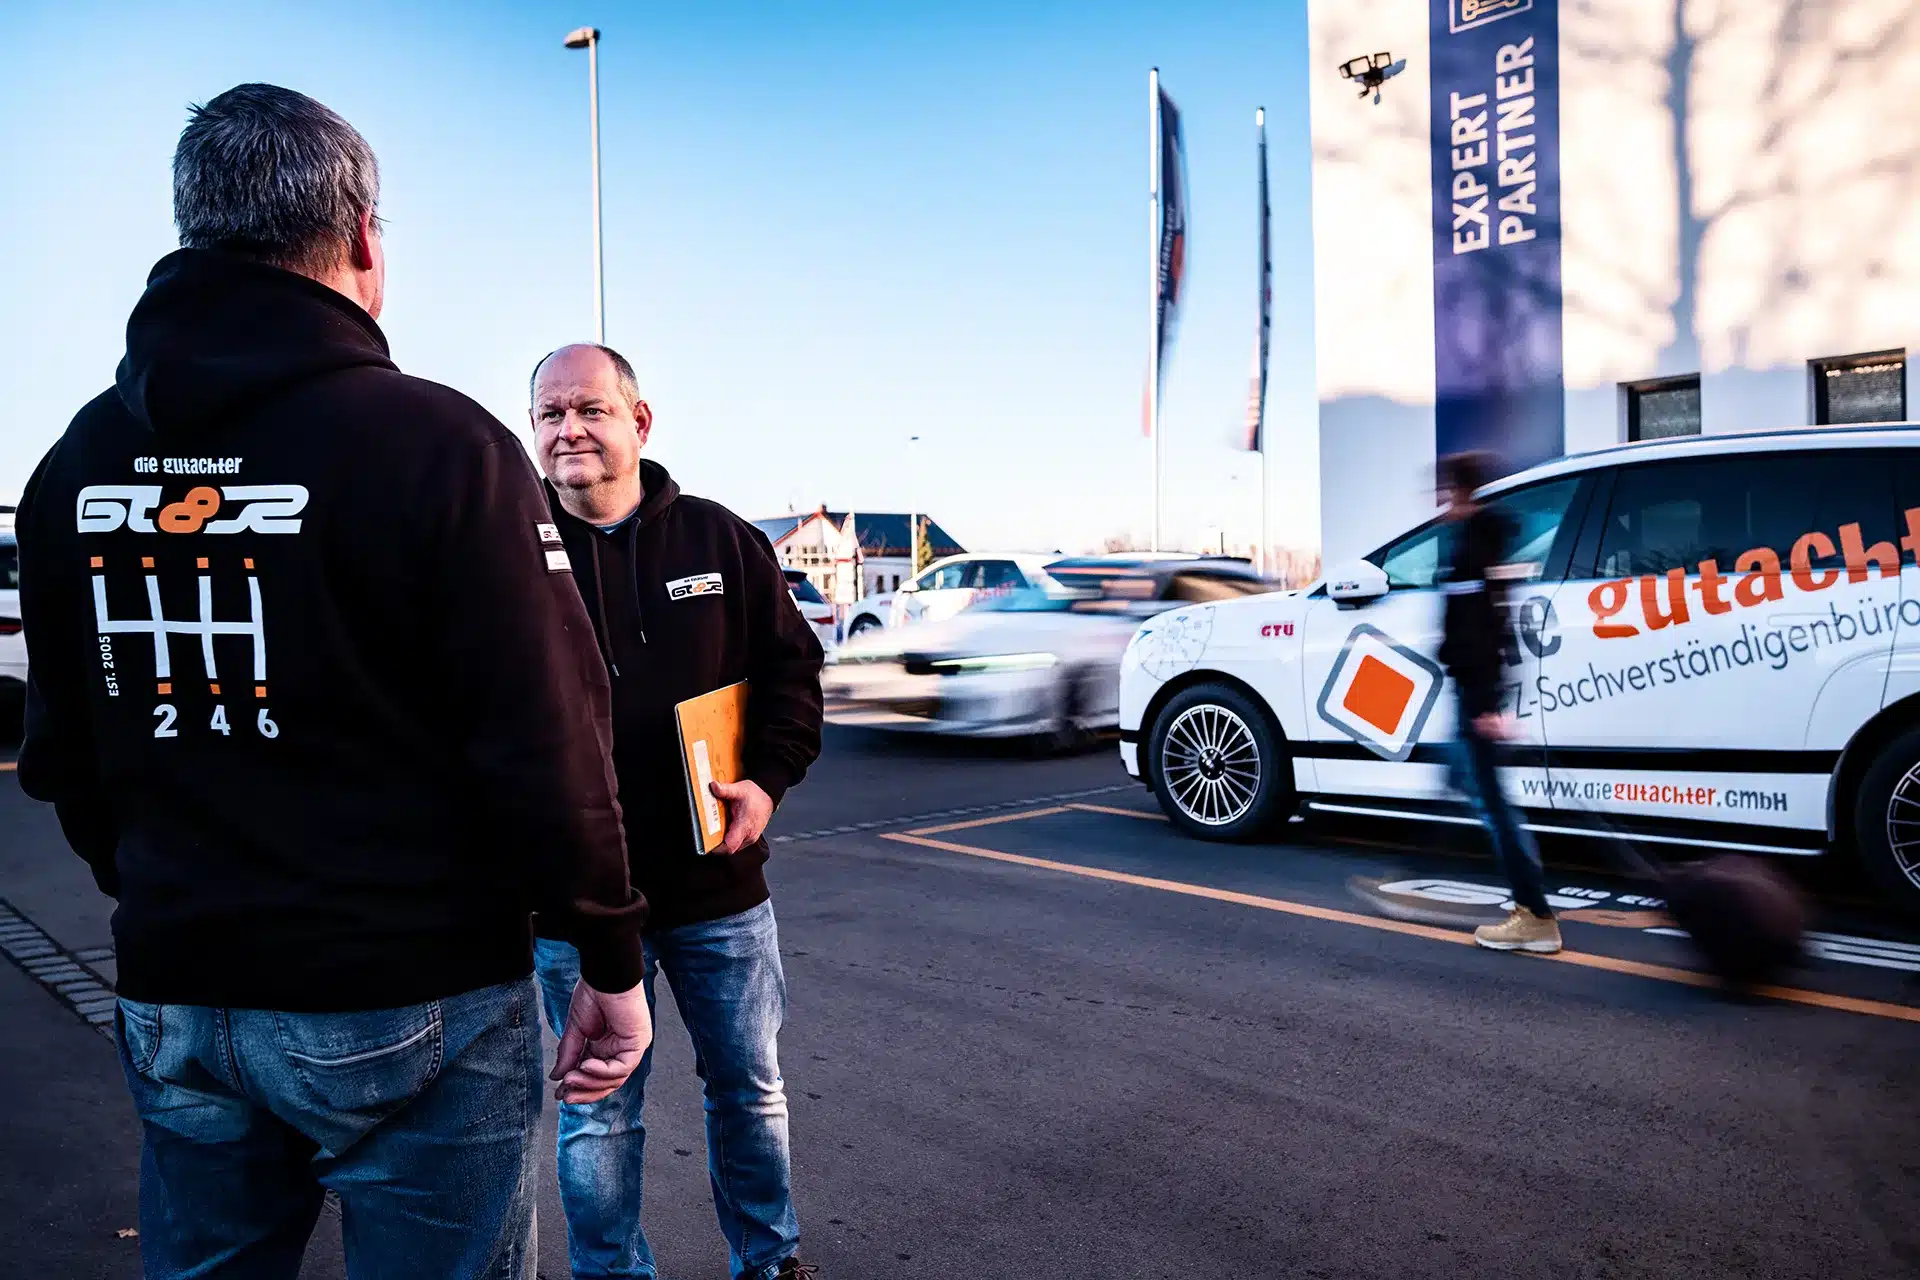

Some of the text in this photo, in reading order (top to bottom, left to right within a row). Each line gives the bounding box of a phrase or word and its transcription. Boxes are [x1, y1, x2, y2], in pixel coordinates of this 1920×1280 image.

[1495, 36, 1537, 246] PARTNER
[1450, 91, 1490, 255] EXPERT
[134, 457, 243, 475] die gutachter
[99, 636, 119, 697] EST. 2005
[153, 704, 280, 739] 2 4 6
